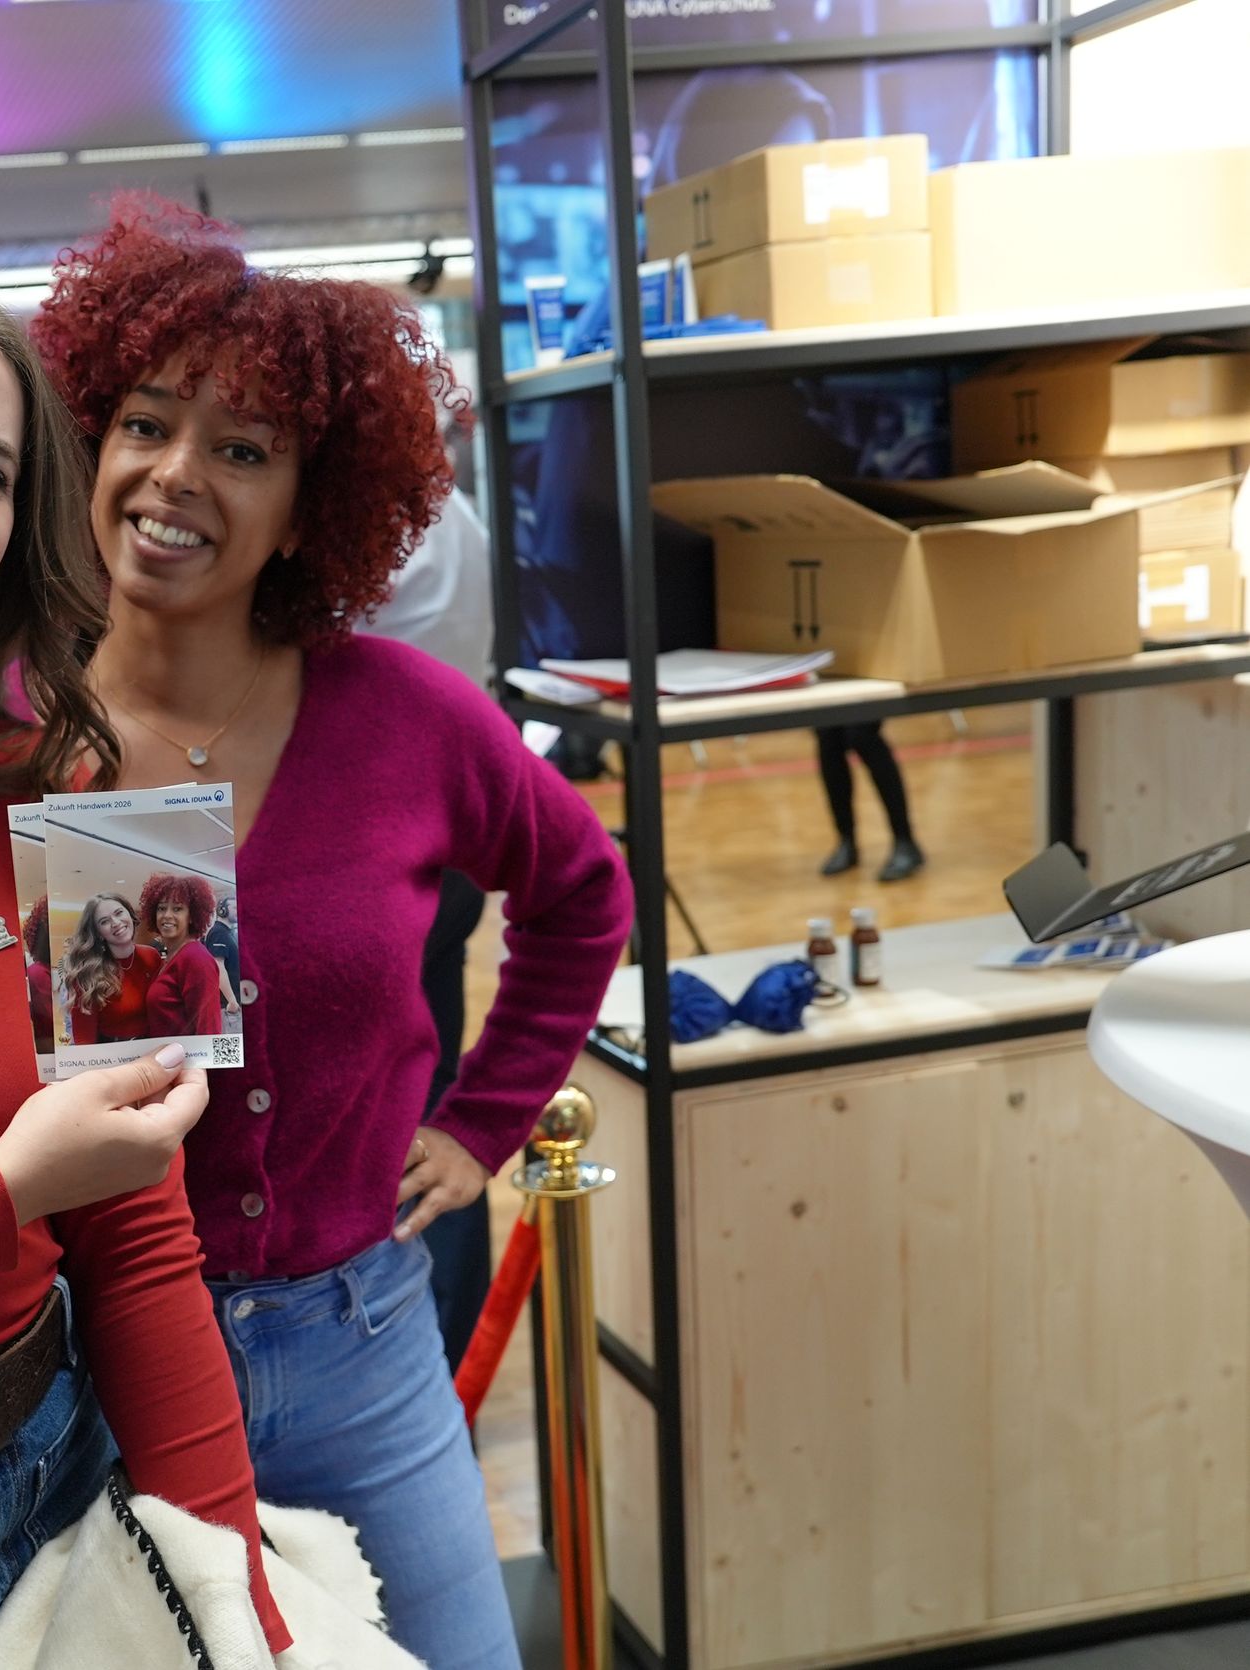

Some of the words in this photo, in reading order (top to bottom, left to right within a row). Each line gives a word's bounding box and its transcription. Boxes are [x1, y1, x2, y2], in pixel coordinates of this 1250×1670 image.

[624, 0, 667, 19] UNA
[164, 797, 190, 805] SIGNAL
[191, 795, 213, 803] IDUNA
[48, 802, 75, 812] Zukunft
[77, 801, 112, 811] Handwerk
[114, 800, 132, 809] 2026
[14, 813, 41, 822] Zukunft
[58, 1060, 87, 1068] SIGNAL
[88, 1058, 112, 1066] IDUNA
[43, 1066, 56, 1074] SIG
